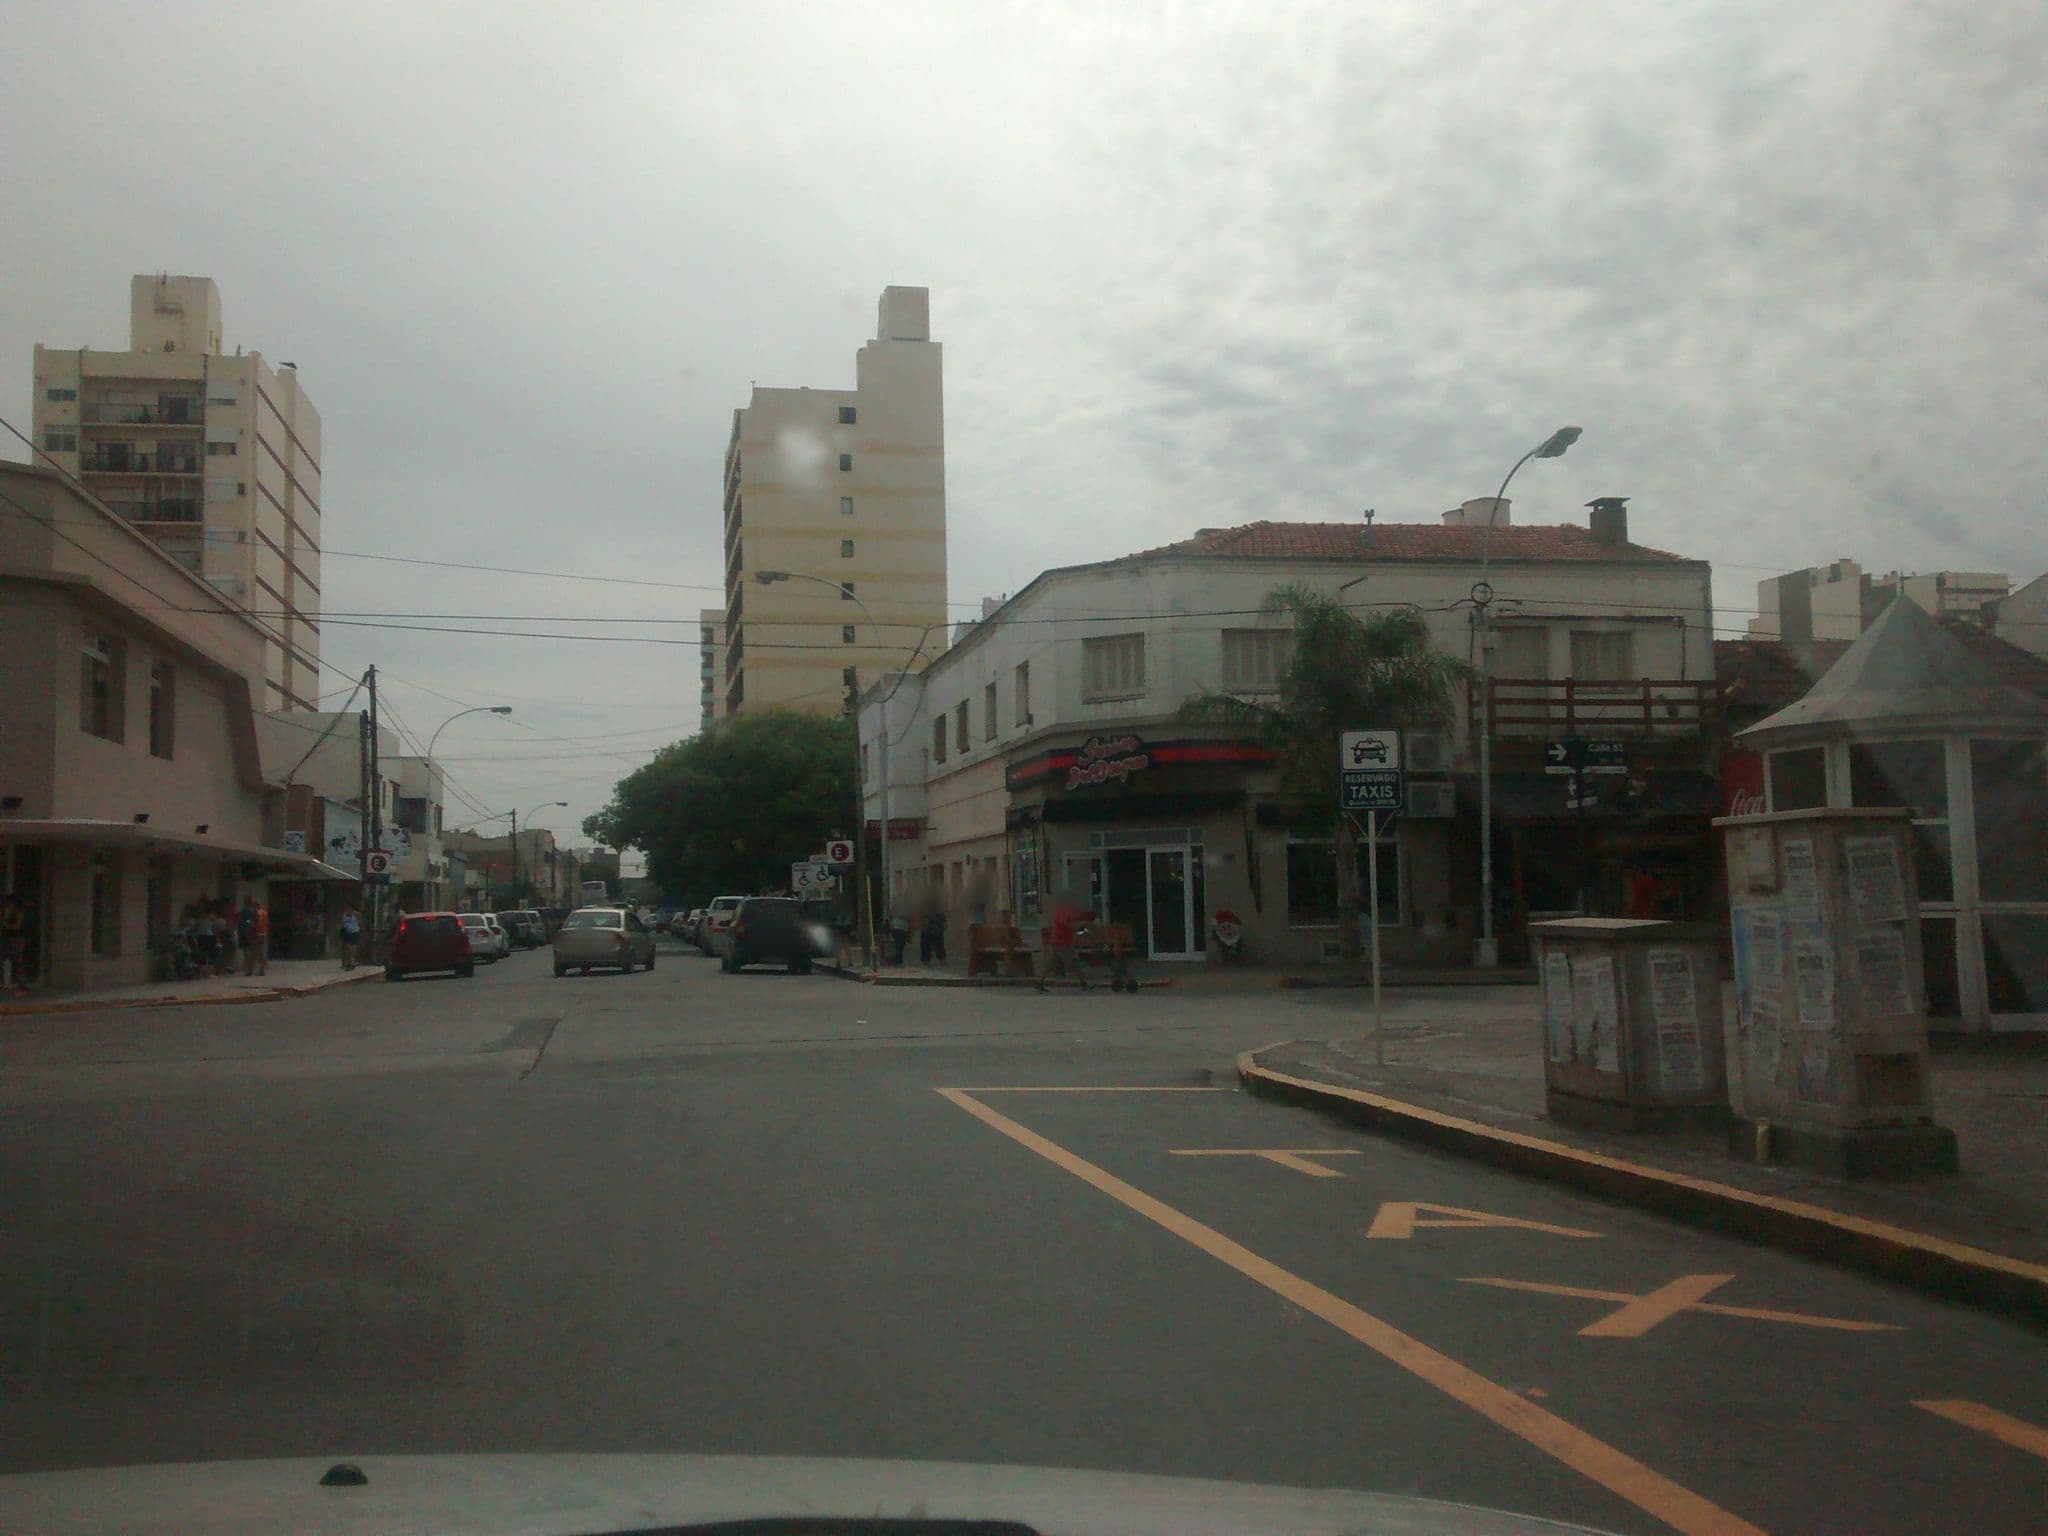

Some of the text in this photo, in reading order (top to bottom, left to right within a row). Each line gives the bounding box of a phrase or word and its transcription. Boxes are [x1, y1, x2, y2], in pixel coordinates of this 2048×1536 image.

[1588, 743, 1610, 753] Calle
[1345, 774, 1397, 783] RESERVADO
[1350, 785, 1394, 798] TAXIS
